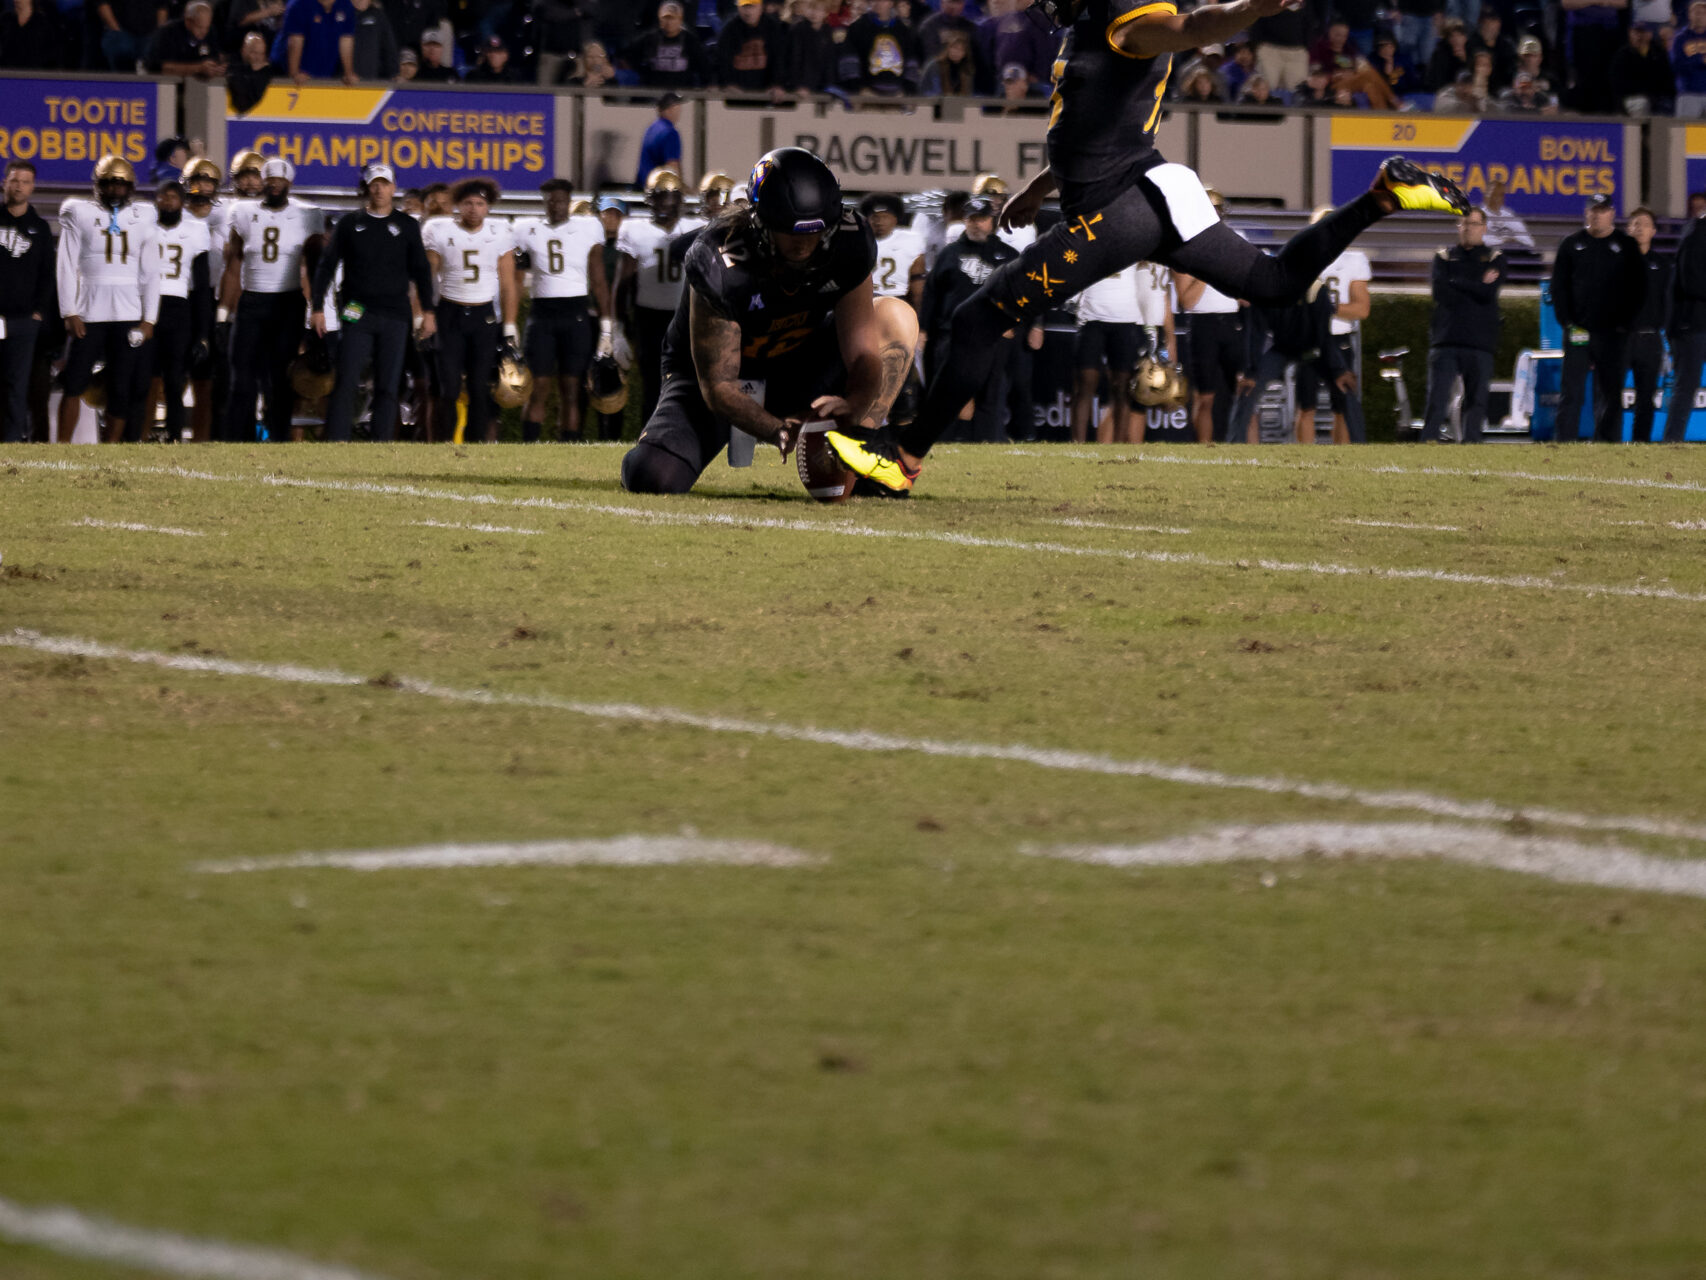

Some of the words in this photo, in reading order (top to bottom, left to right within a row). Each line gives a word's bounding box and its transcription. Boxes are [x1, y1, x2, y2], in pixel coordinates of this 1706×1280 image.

[45, 96, 146, 125] TOOTIE
[287, 92, 299, 110] 7
[382, 109, 545, 136] CONFERENCE
[1393, 123, 1416, 140] 20
[0, 128, 146, 162] ROBBINS
[254, 133, 544, 172] CHAMPIONSHIPS
[1540, 136, 1616, 163] BOWL
[101, 230, 128, 264] 11
[262, 227, 280, 263] 8
[547, 239, 565, 274] 6
[463, 250, 480, 283] 5
[873, 257, 897, 290] 2
